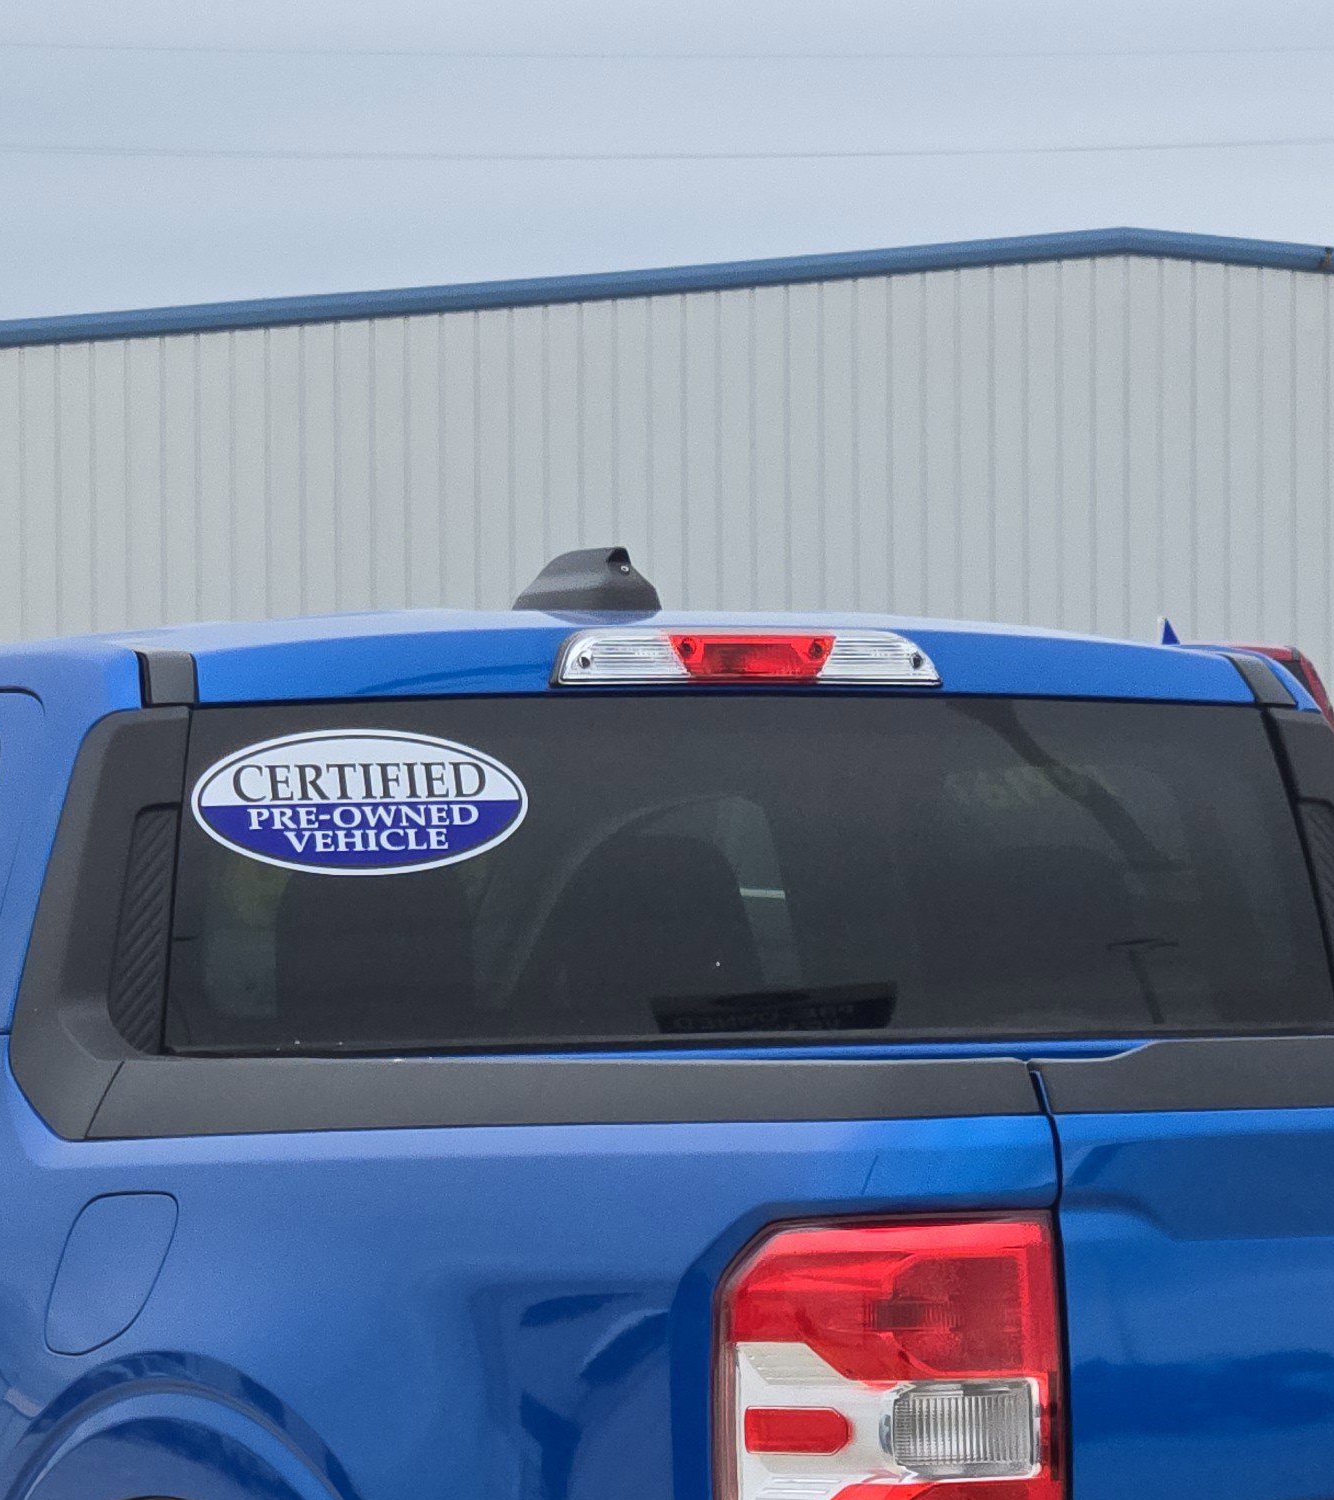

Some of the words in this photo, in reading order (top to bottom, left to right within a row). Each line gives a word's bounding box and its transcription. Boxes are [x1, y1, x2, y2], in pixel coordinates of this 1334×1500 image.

[232, 761, 486, 802] CERTIFIED
[247, 804, 479, 830] PRE-OWNED
[284, 828, 449, 853] VEHICLE
